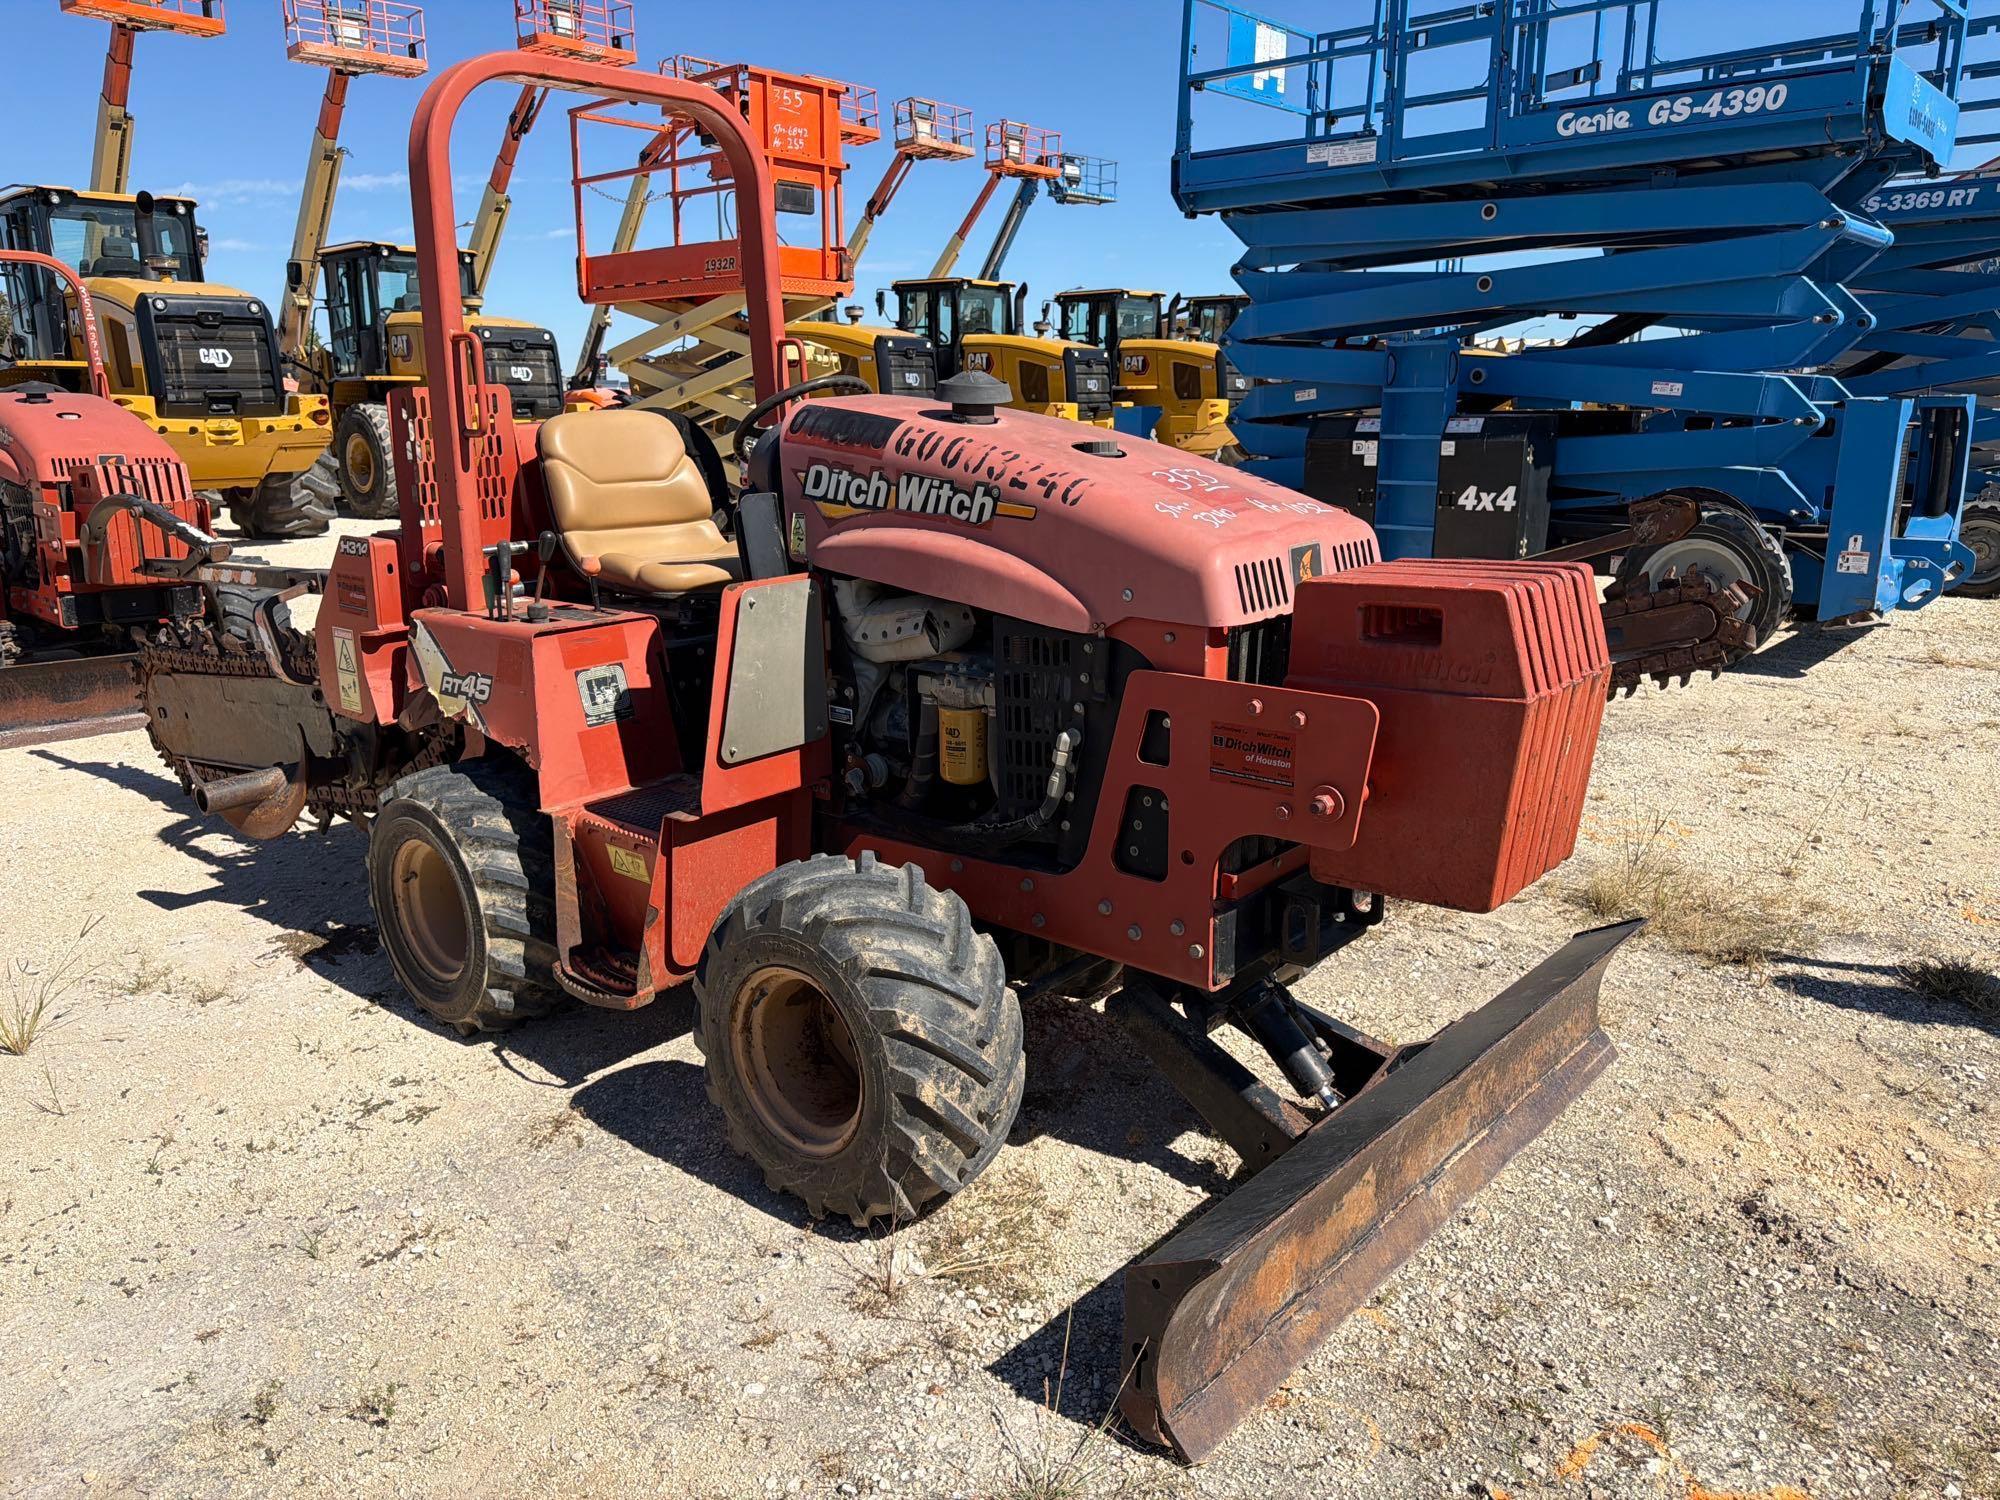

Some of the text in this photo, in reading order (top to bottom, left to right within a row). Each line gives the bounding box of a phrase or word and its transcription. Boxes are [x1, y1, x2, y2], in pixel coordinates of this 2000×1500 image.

[773, 88, 804, 109] 355
[1556, 84, 1788, 137] Genie GS-4390
[1947, 187, 1980, 207] RT
[704, 257, 736, 272] 1932R
[391, 335, 408, 357] CAT
[199, 348, 229, 366] CAT
[967, 352, 988, 370] CAT
[1124, 355, 1144, 371] CAT
[511, 366, 530, 380] CAT
[805, 464, 888, 508] Ditch
[1457, 486, 1517, 512] 4x4
[442, 675, 492, 701] RT45
[1245, 754, 1291, 769] of Houston
